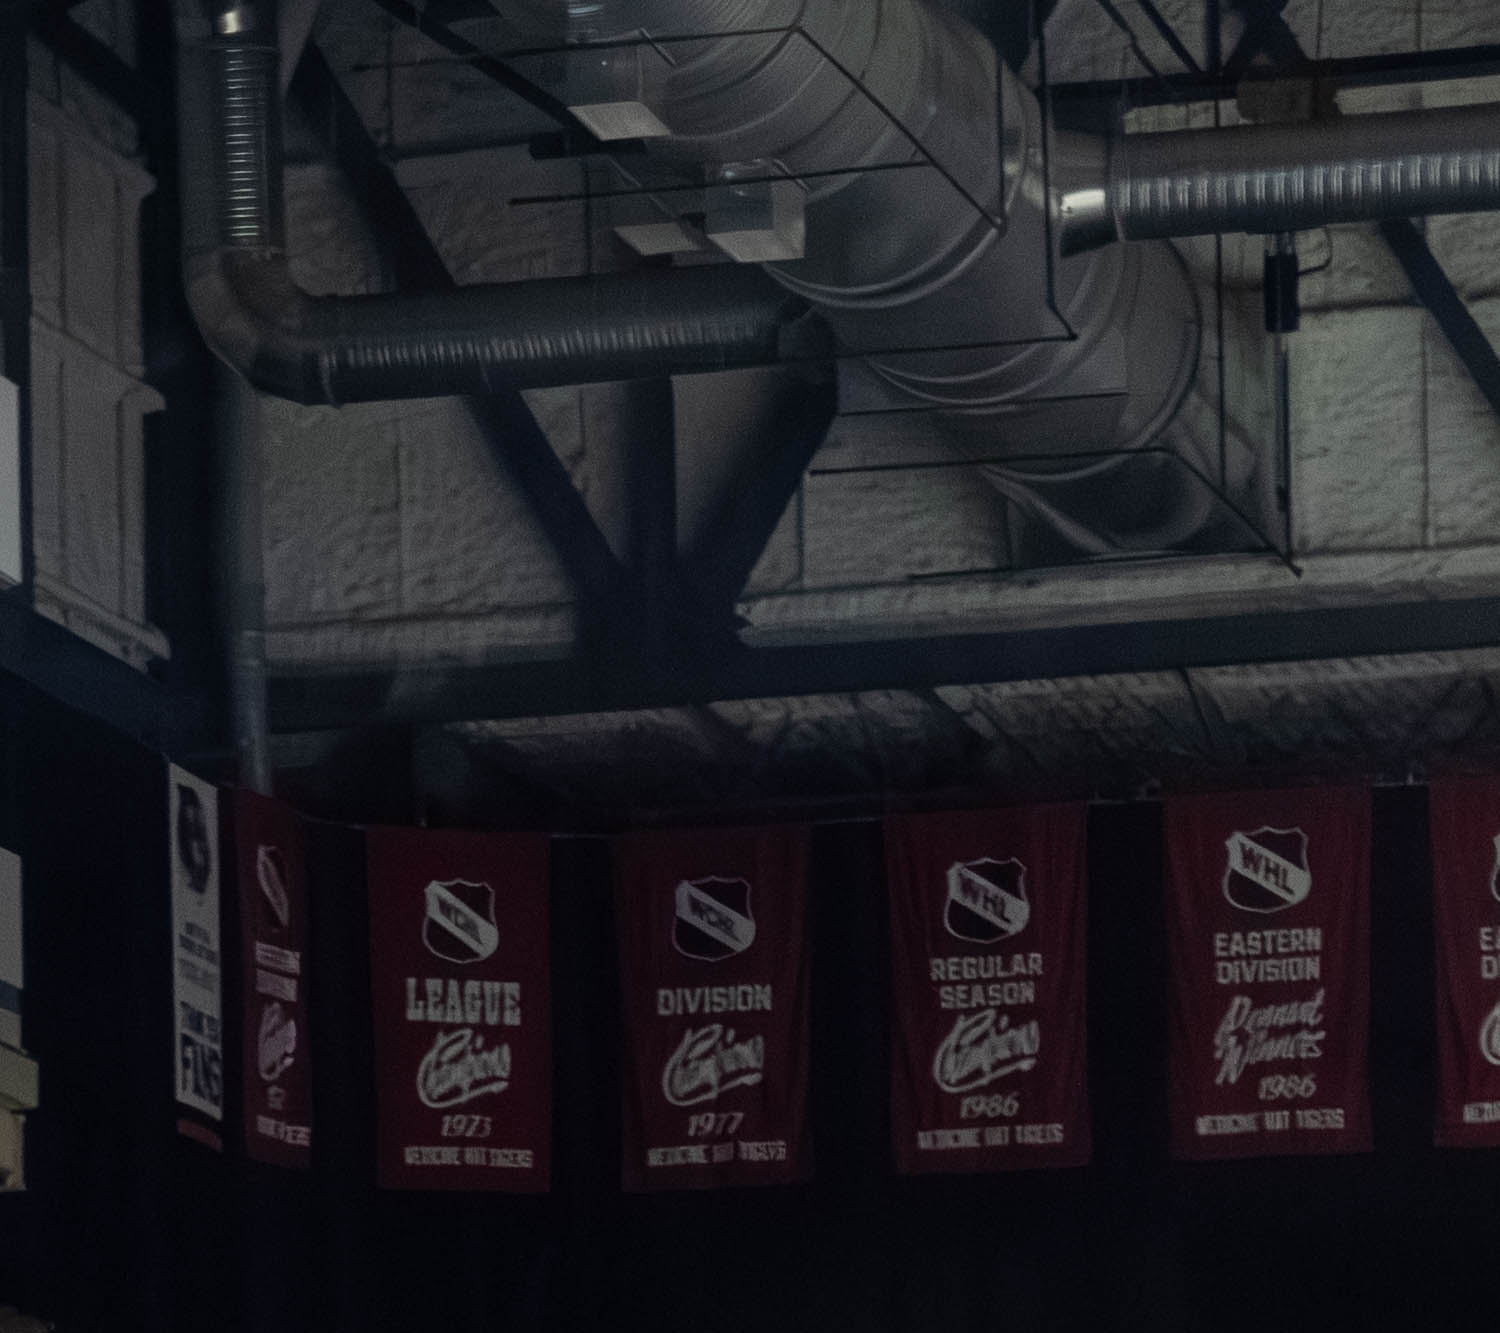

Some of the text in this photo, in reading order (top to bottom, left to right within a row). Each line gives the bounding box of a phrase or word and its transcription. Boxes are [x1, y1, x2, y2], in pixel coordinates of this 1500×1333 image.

[1239, 842, 1296, 895] WHL
[1214, 927, 1323, 957] EASTERN
[930, 953, 1044, 981] REGULAR
[1215, 955, 1321, 986] DIVISION
[405, 977, 522, 1027] LEAGUE
[656, 984, 773, 1016] DIVISION
[939, 981, 1036, 1010] SEASON
